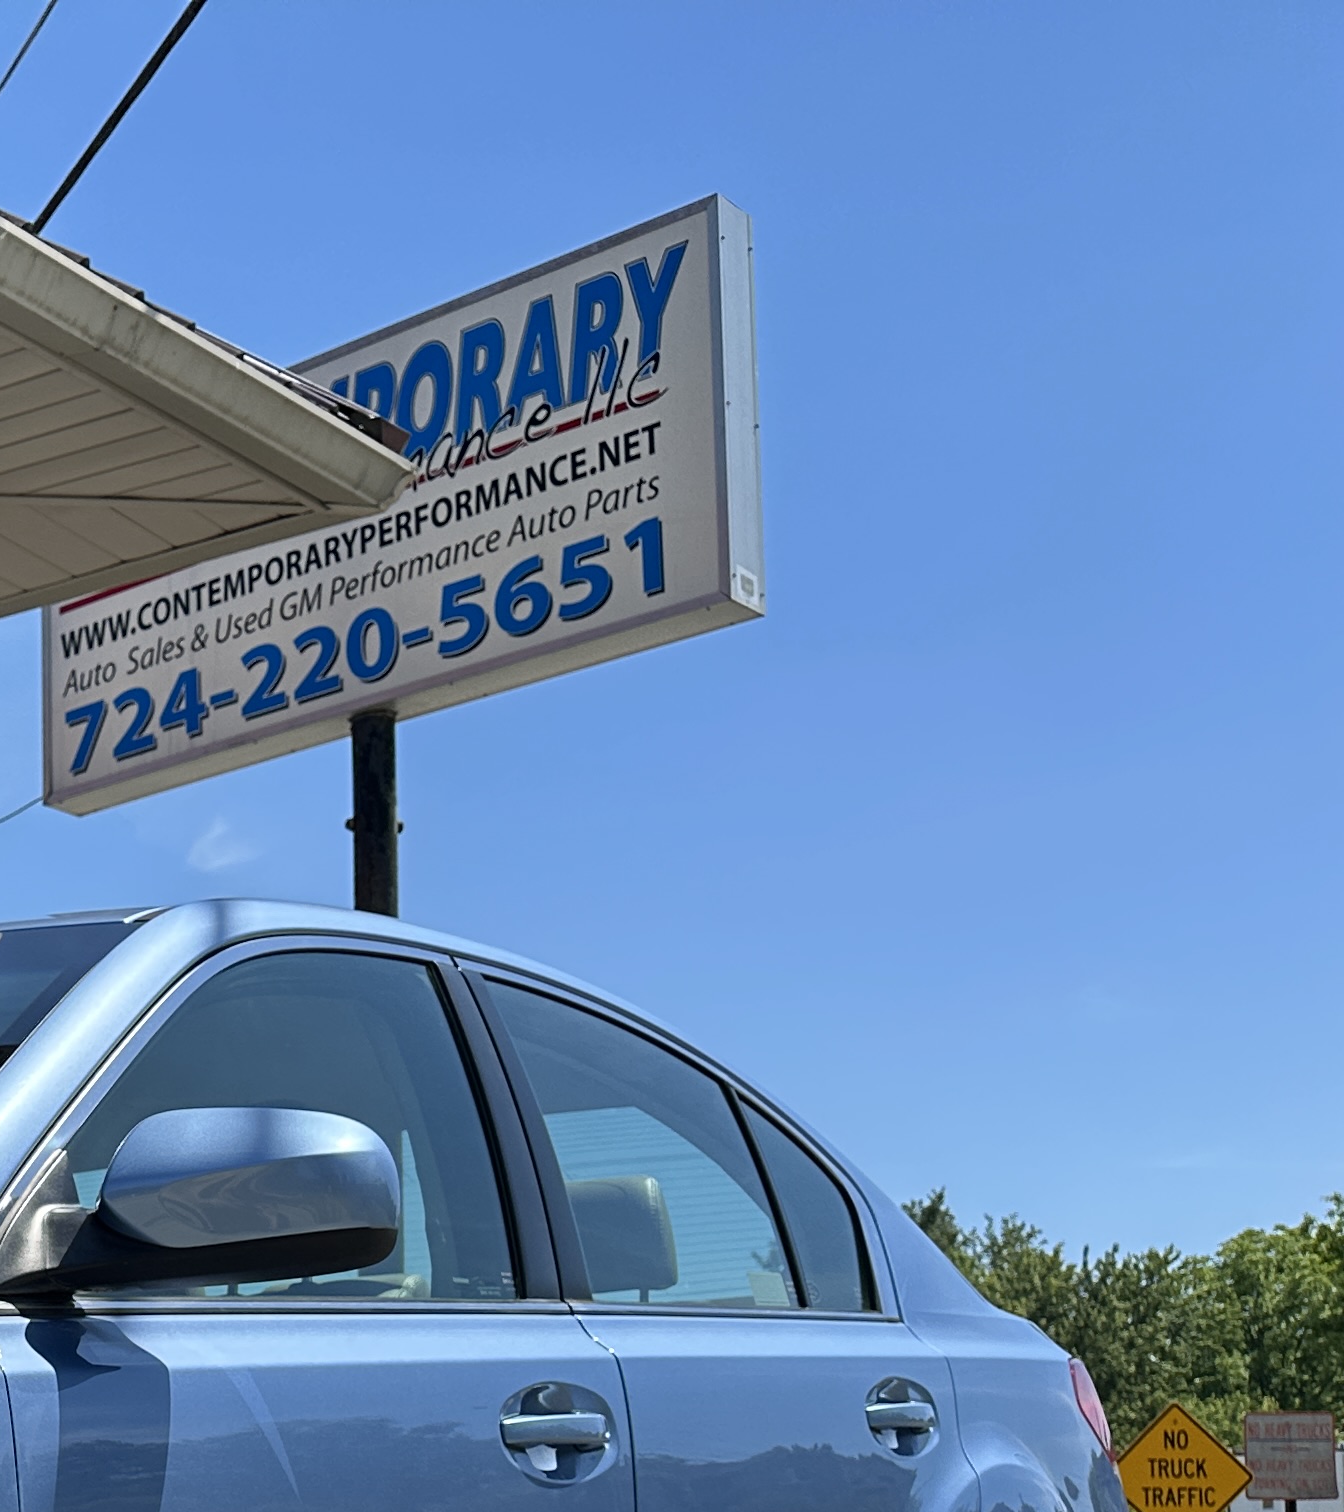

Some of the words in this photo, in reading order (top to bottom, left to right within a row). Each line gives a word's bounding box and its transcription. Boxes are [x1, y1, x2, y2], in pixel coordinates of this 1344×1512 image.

[329, 239, 690, 461] PORARY
[60, 421, 662, 660] WWW.CONTEMPORARYPERFORMANCE.NET
[63, 660, 117, 698] Auto
[126, 634, 186, 676] Sales
[190, 622, 210, 653] &
[215, 597, 274, 645] Used
[280, 582, 324, 622] GM
[328, 526, 501, 608] Performance
[507, 504, 577, 548] Auto
[584, 474, 660, 522] Parts
[64, 516, 666, 777] 724-220-5651
[1141, 1486, 1217, 1509] TRAFFIC
[1147, 1457, 1208, 1480] TRUCK
[1163, 1429, 1189, 1451] NO
